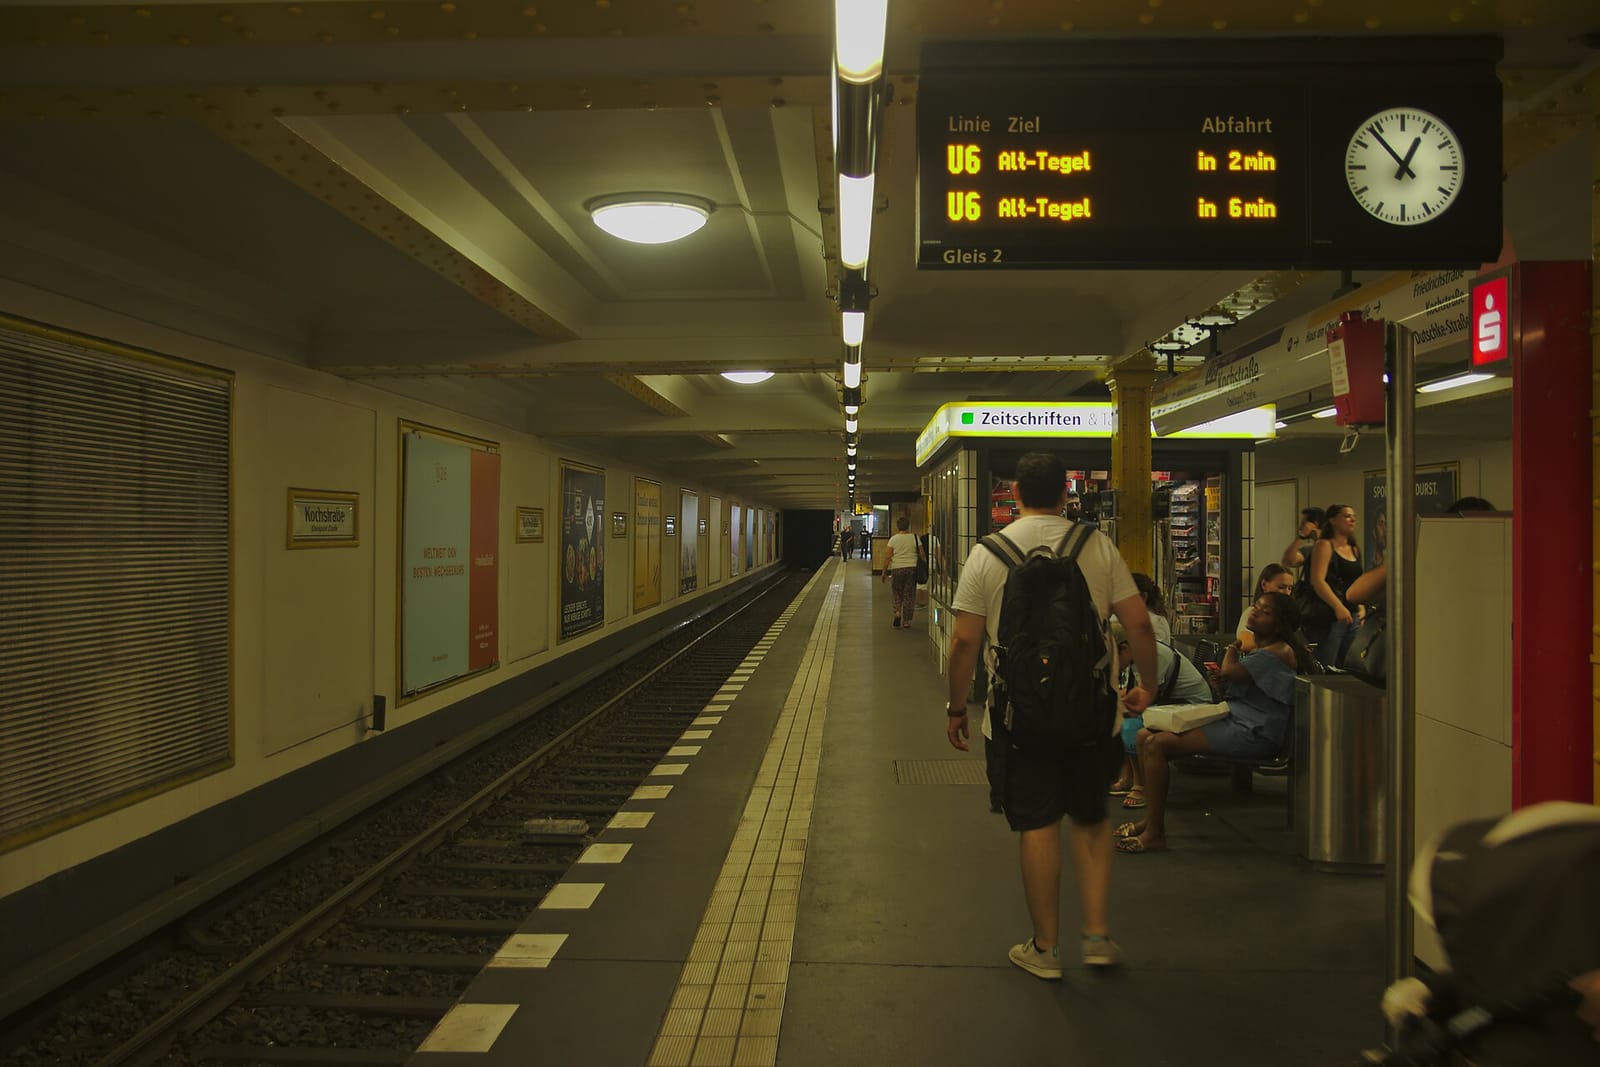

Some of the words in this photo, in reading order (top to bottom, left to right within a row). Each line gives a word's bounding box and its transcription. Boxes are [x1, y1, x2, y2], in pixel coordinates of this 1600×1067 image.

[948, 115, 991, 132] Linie
[1007, 116, 1040, 133] Ziel
[1201, 115, 1273, 133] Abfahrt
[947, 144, 982, 175] U6
[998, 150, 1092, 175] Alt-Tegel
[1197, 150, 1217, 171] in
[947, 191, 982, 221] U6
[998, 197, 1092, 221] Alt-Tegel
[1198, 197, 1217, 218] in
[943, 248, 987, 264] Gleis
[992, 248, 1002, 263] 2
[980, 410, 1082, 426] Zeitschriften
[304, 506, 345, 523] Kochstraße
